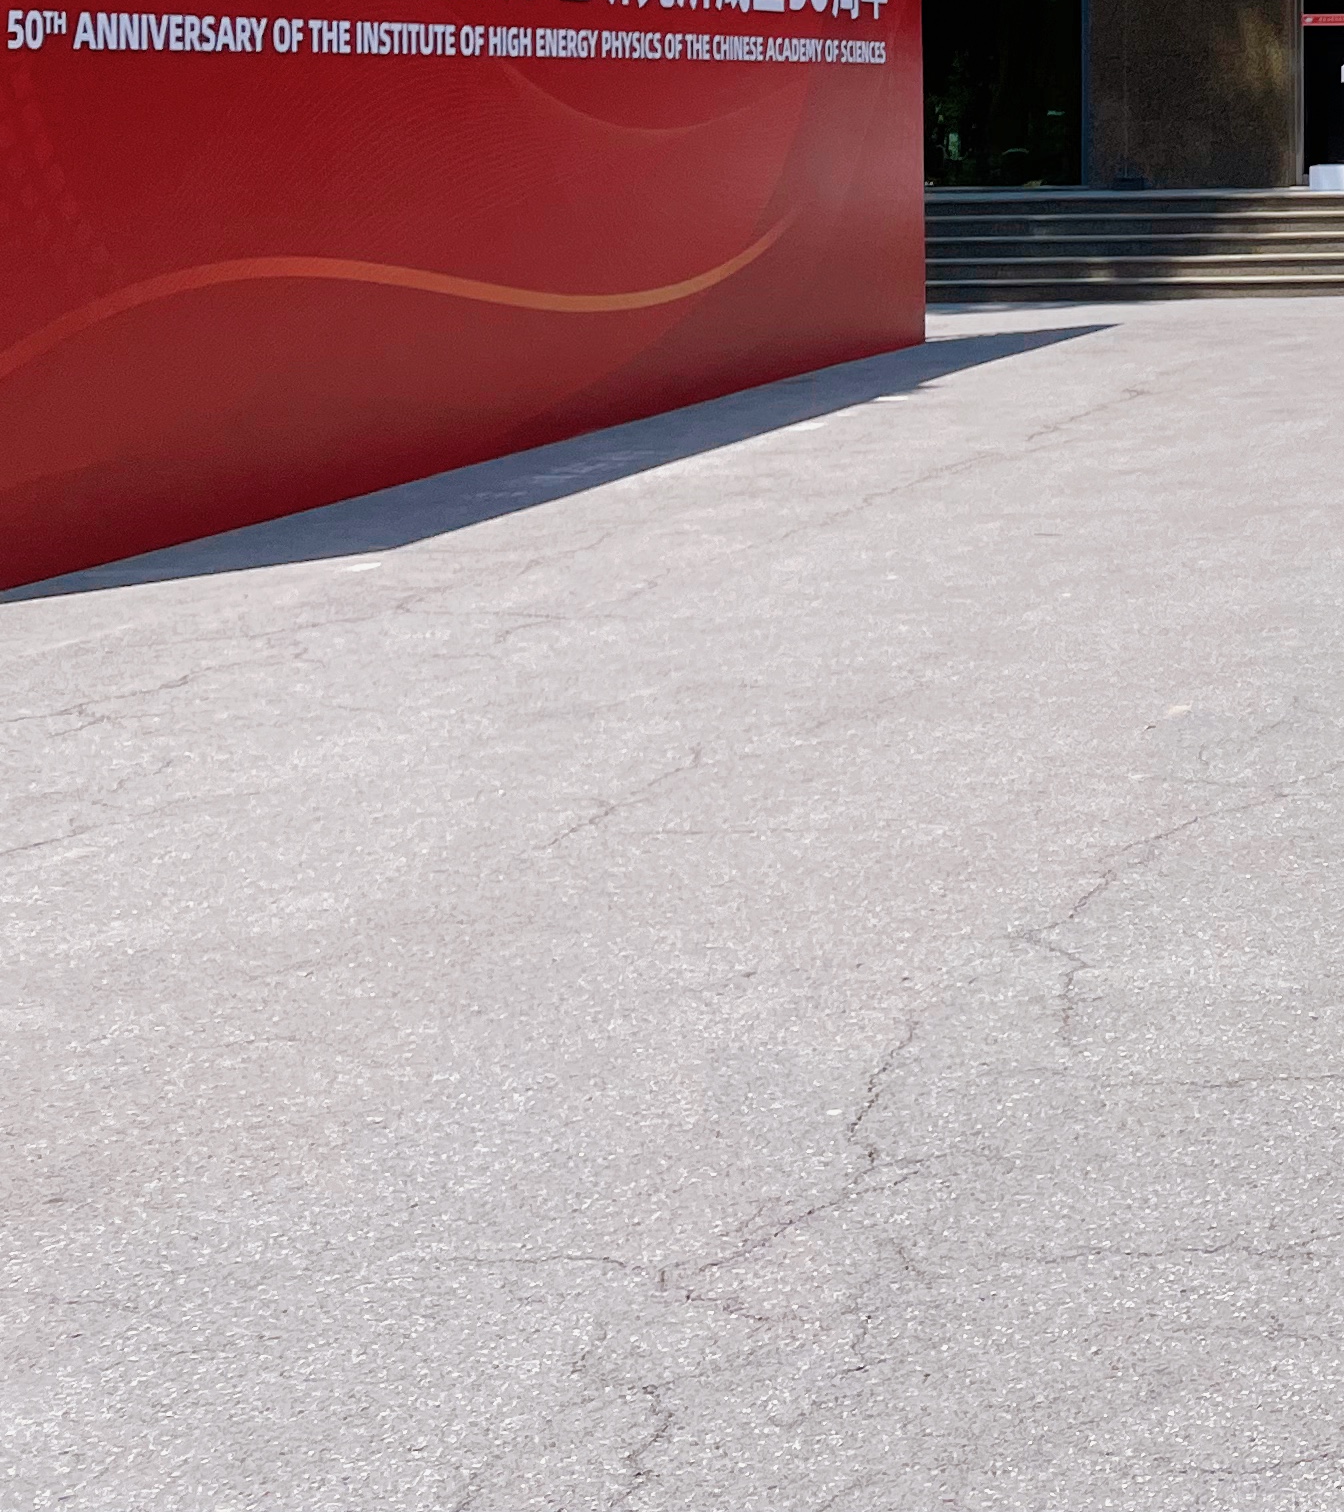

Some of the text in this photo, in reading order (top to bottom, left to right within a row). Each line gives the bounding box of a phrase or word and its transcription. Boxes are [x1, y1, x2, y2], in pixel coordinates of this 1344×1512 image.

[8, 10, 887, 64] 50TH ANNIVERSARY OF THE INSTITUTE OF HIGH ENERGY PHYSICS OF THE CHINESE ACADEMY OF SCIENCES
